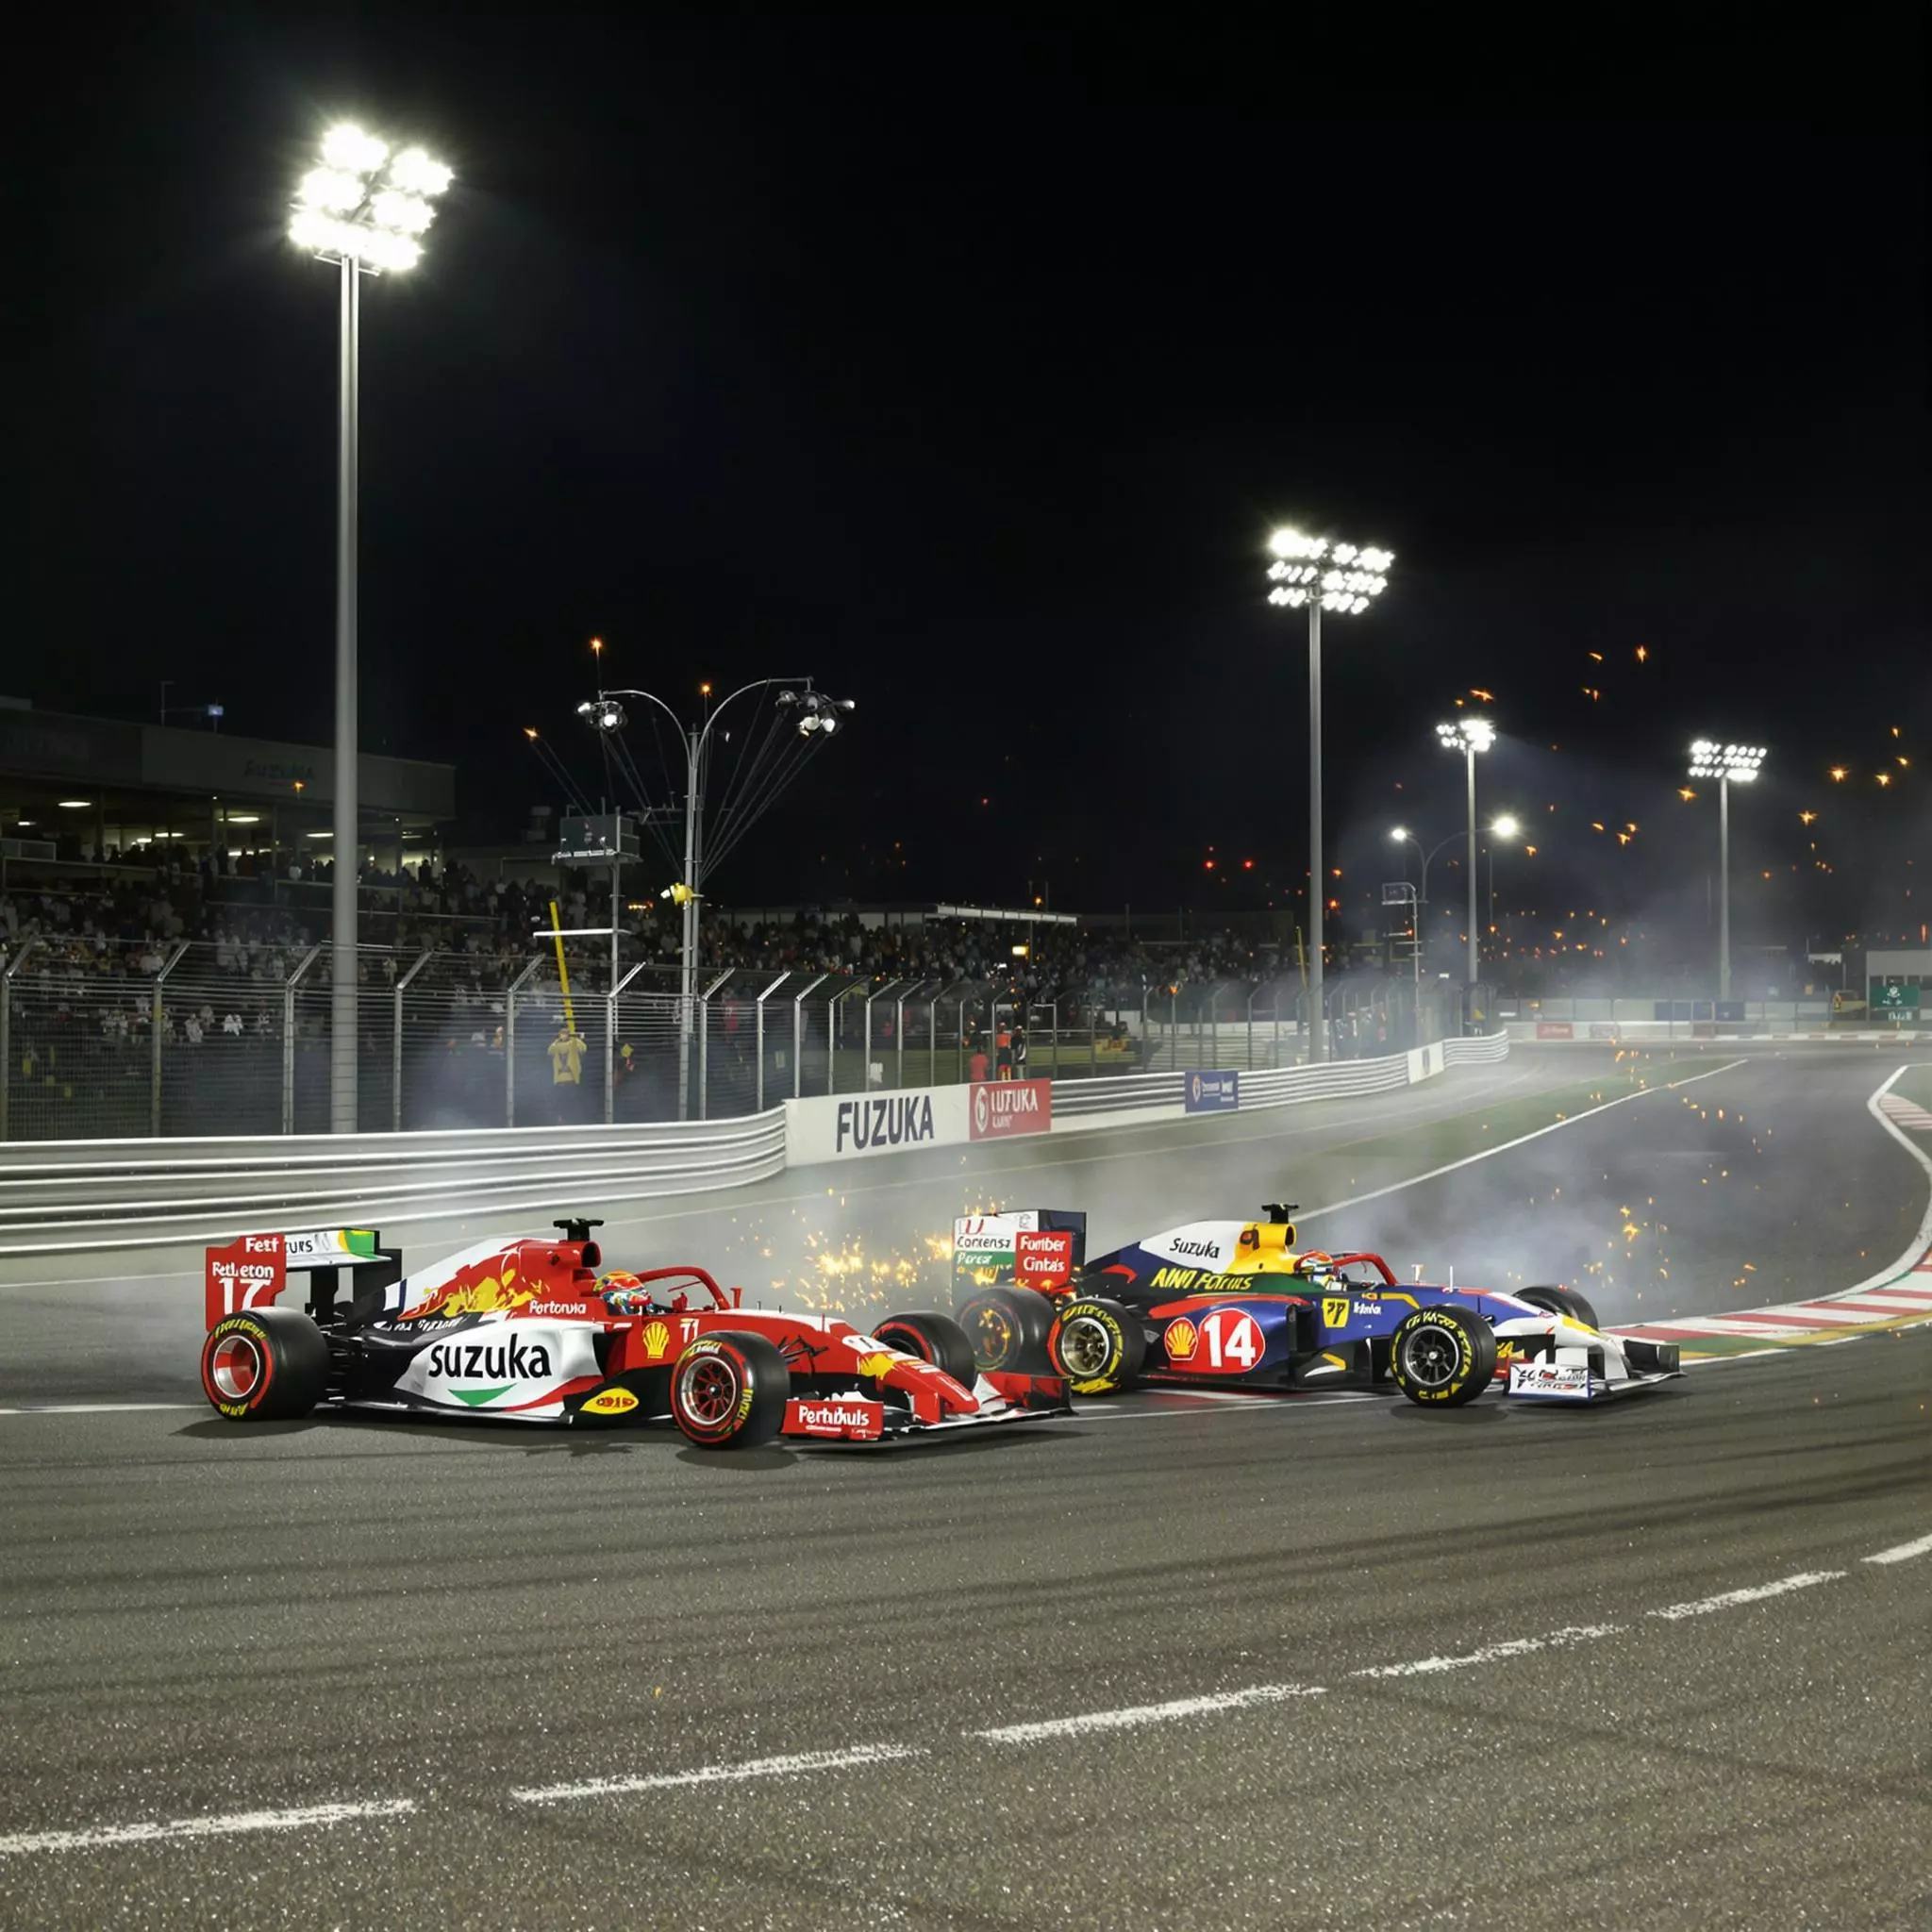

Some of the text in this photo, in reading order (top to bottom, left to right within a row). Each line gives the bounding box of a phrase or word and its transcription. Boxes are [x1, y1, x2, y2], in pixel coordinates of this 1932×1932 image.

[836, 1094, 934, 1153] FUZUKA
[427, 1333, 552, 1379] suzuka
[1204, 1314, 1256, 1367] 14
